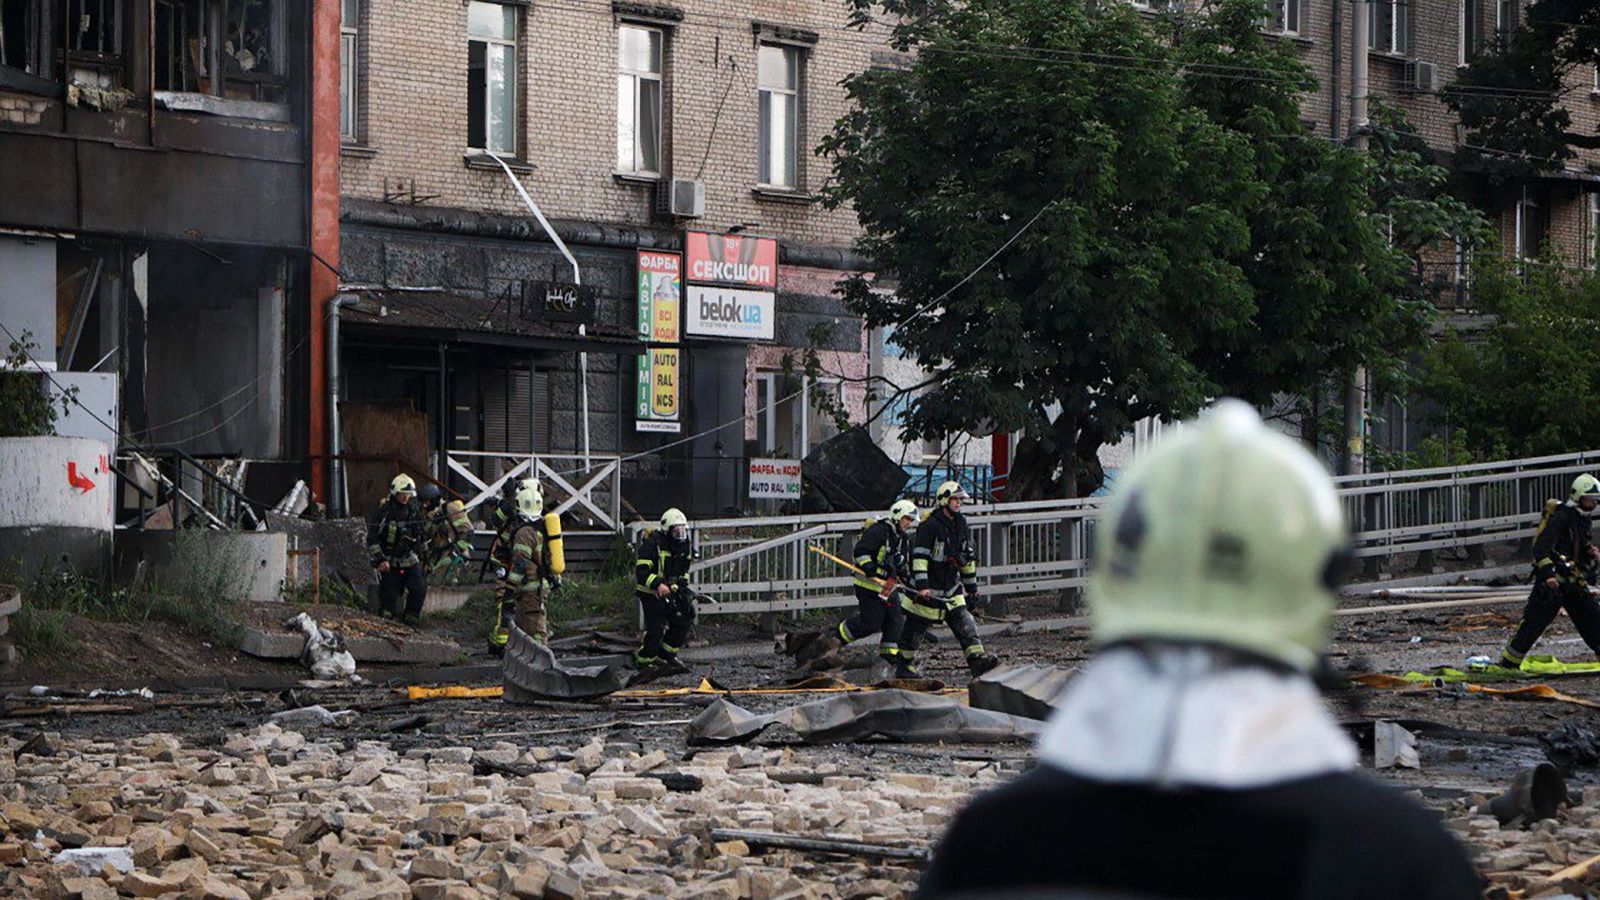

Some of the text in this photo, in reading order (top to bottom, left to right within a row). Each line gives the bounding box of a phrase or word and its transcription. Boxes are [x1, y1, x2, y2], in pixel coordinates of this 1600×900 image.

[640, 255, 678, 270] ФАРБА
[693, 260, 770, 283] СЕКСШОП
[654, 354, 677, 366] AUTO
[657, 374, 673, 386] RAL
[656, 394, 674, 407] NCS
[750, 464, 775, 474] ФАРБА
[751, 482, 800, 494] AUTO RAL NCS
